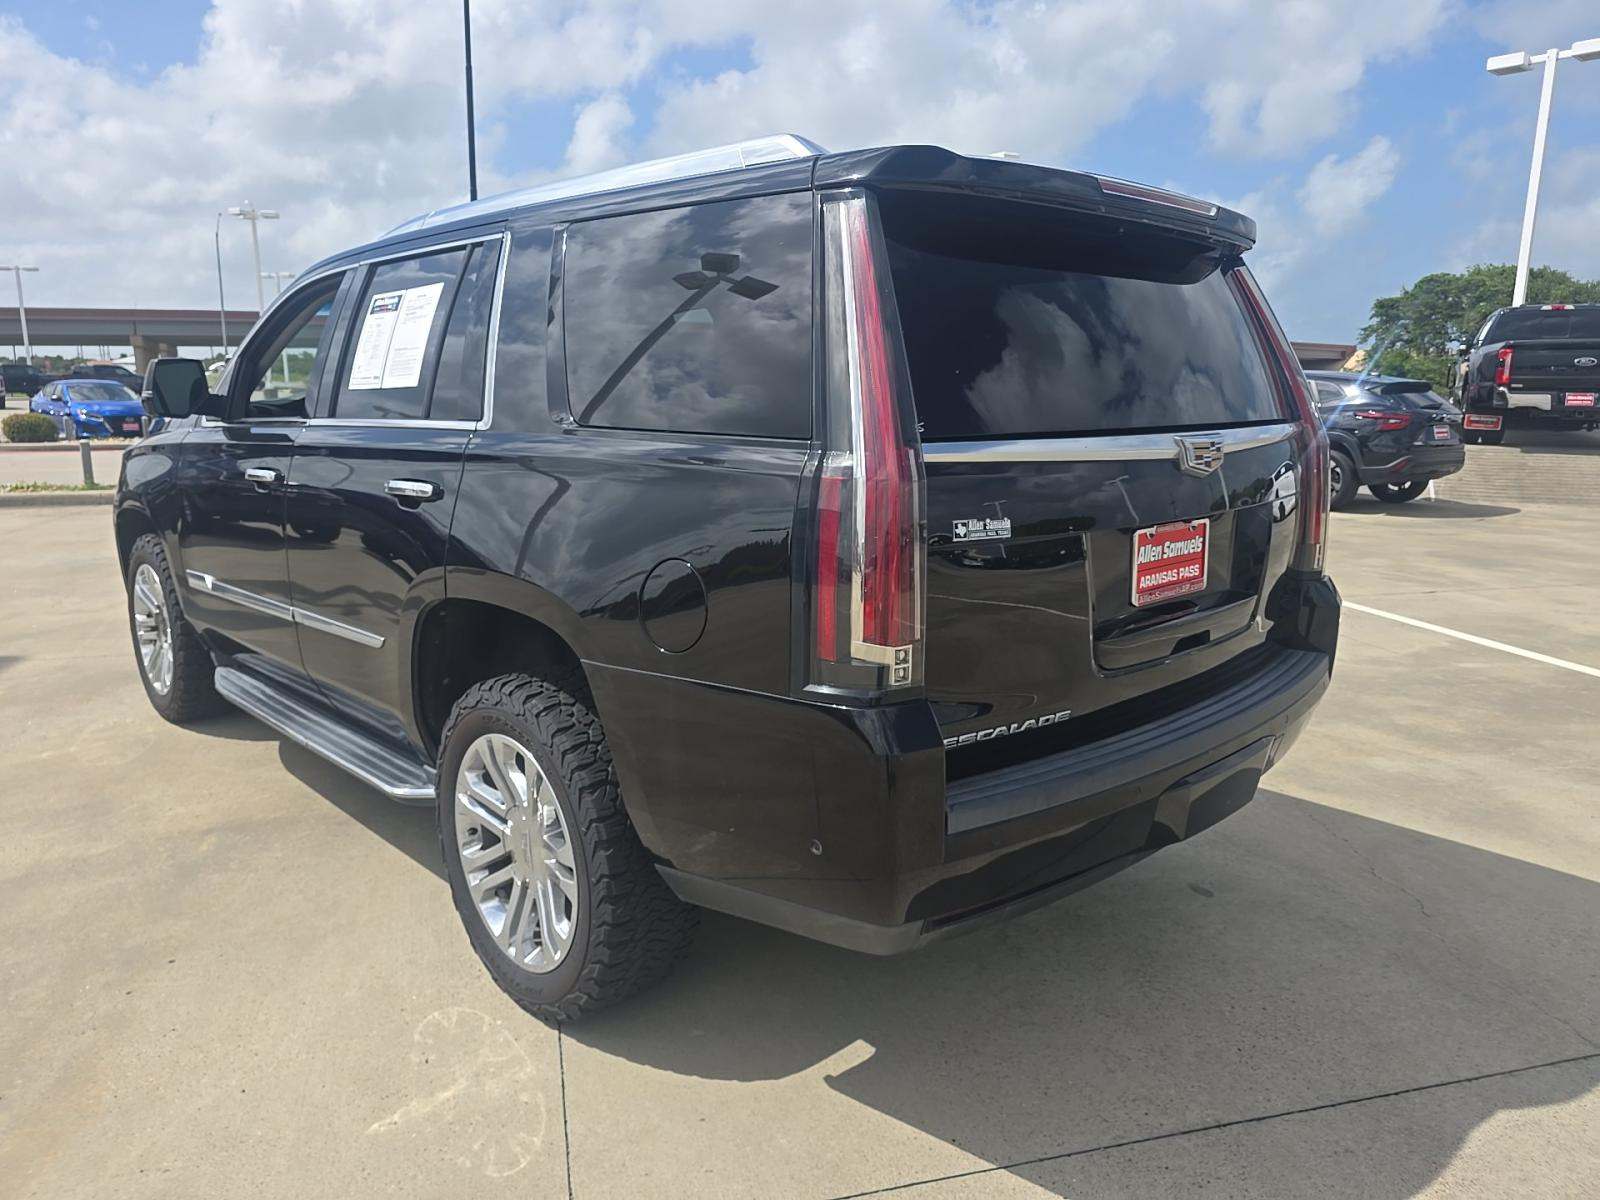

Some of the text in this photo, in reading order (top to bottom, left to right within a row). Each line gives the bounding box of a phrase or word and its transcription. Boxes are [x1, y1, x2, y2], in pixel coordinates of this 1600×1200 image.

[1137, 535, 1203, 564] Allen Samuels
[1139, 564, 1200, 589] ARANSAS PASS
[943, 710, 1071, 749] ESCALADE
